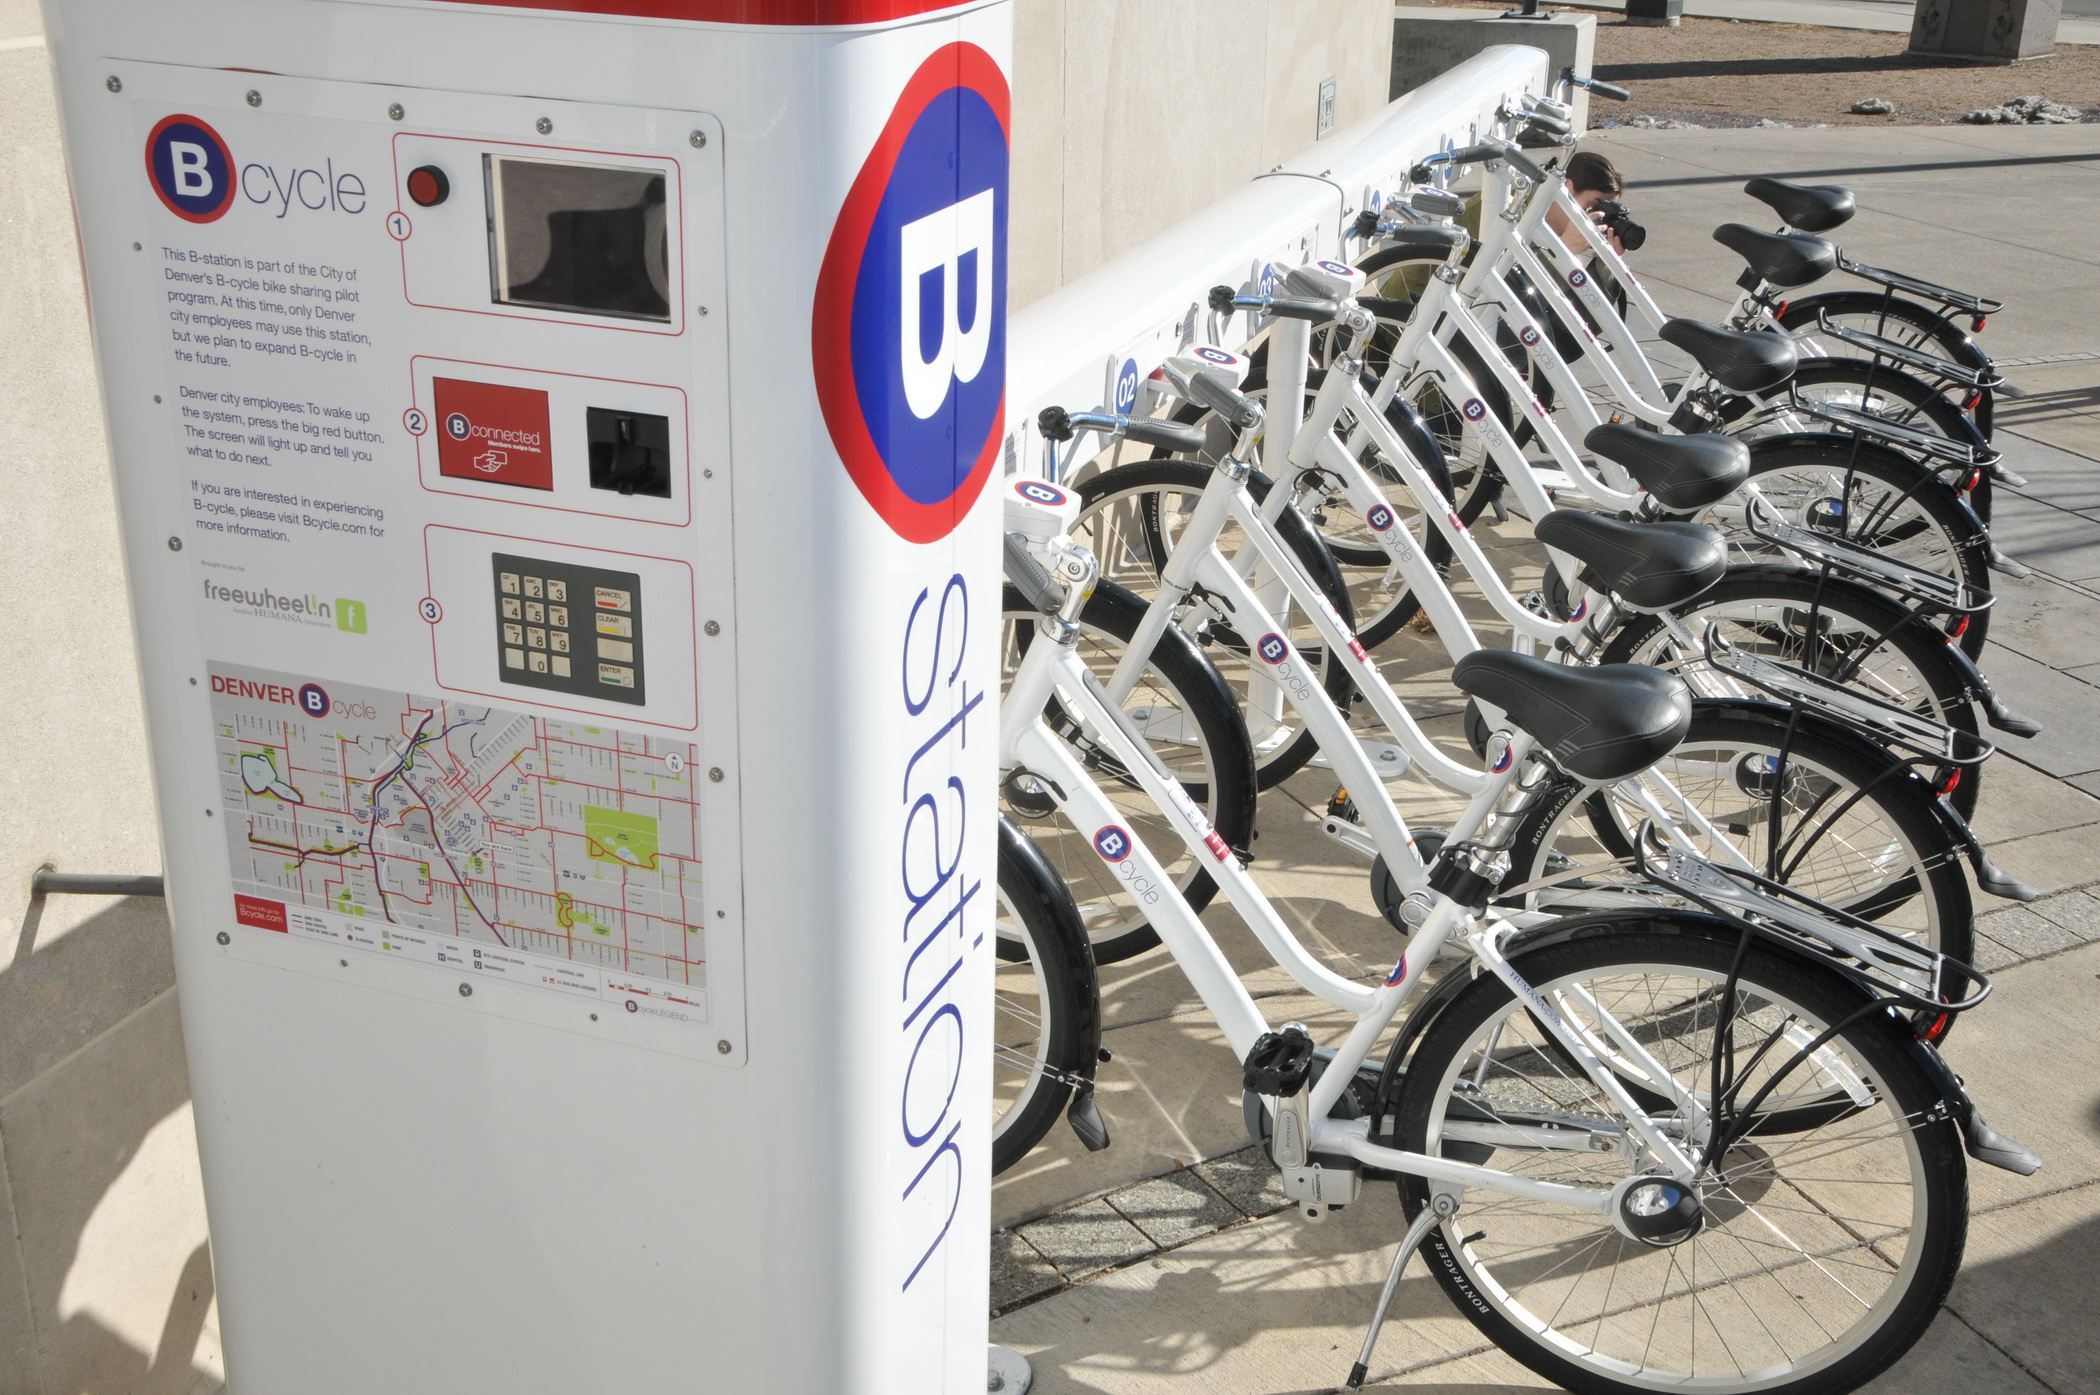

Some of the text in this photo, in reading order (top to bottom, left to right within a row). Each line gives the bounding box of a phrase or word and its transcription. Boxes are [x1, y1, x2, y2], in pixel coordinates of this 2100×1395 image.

[170, 140, 366, 218] B cycle
[394, 218, 402, 235] 1
[161, 247, 357, 283] This B-station is part of the City of
[1325, 263, 1346, 273] B
[165, 268, 360, 303] Denver's B-cycle bike sharing pilot
[1572, 272, 1601, 310] B cycle
[168, 291, 356, 322] program. At this time, only Denver
[901, 187, 994, 420] B
[170, 310, 372, 347] city employees may use this station,
[172, 329, 357, 363] but we plan to expand B-cycle in
[1204, 350, 1228, 362] B
[1524, 329, 1555, 372] B cycle
[175, 349, 231, 367] the future.
[1118, 372, 1136, 408] 02
[180, 386, 370, 424] Denver city employees: To wake up
[182, 406, 385, 444] the system, press the big red button.
[410, 413, 421, 430] 2
[453, 419, 540, 446] B connected
[1467, 402, 1503, 448] B cycle
[184, 425, 373, 463] The screen will light up and tell you
[488, 440, 512, 449] Members
[512, 443, 528, 452] swipe
[187, 445, 272, 467] what to do next.
[191, 480, 384, 522] If you are interested in experiencing
[1026, 485, 1056, 502] B
[194, 499, 385, 538] B-cycle, please visit Bcycle.com for
[196, 520, 290, 542] more information.
[1372, 509, 1413, 563] B cycle
[510, 582, 515, 592] 1
[533, 586, 540, 596] 2
[556, 589, 563, 600] 3
[596, 590, 623, 600] CANCEL
[254, 608, 303, 624] HUMANA
[347, 605, 355, 628] f
[426, 602, 436, 618] 3
[512, 608, 518, 618] 4
[534, 611, 542, 621] 5
[558, 615, 566, 626] 6
[597, 614, 619, 624] CLEAR
[513, 632, 520, 642] 7
[536, 636, 544, 647] 8
[560, 640, 566, 650] 9
[538, 661, 545, 672] 0
[600, 666, 621, 675] ENTER
[1263, 639, 1310, 702] B cycle
[210, 674, 377, 720] DENVER B cycle
[671, 761, 679, 770] N
[1532, 787, 1577, 846] BONTRAGER
[1100, 832, 1160, 905] B cycle
[240, 907, 283, 923] Bcycle.com
[902, 573, 985, 1294] station
[1435, 1242, 1490, 1314] BONTRAGER
